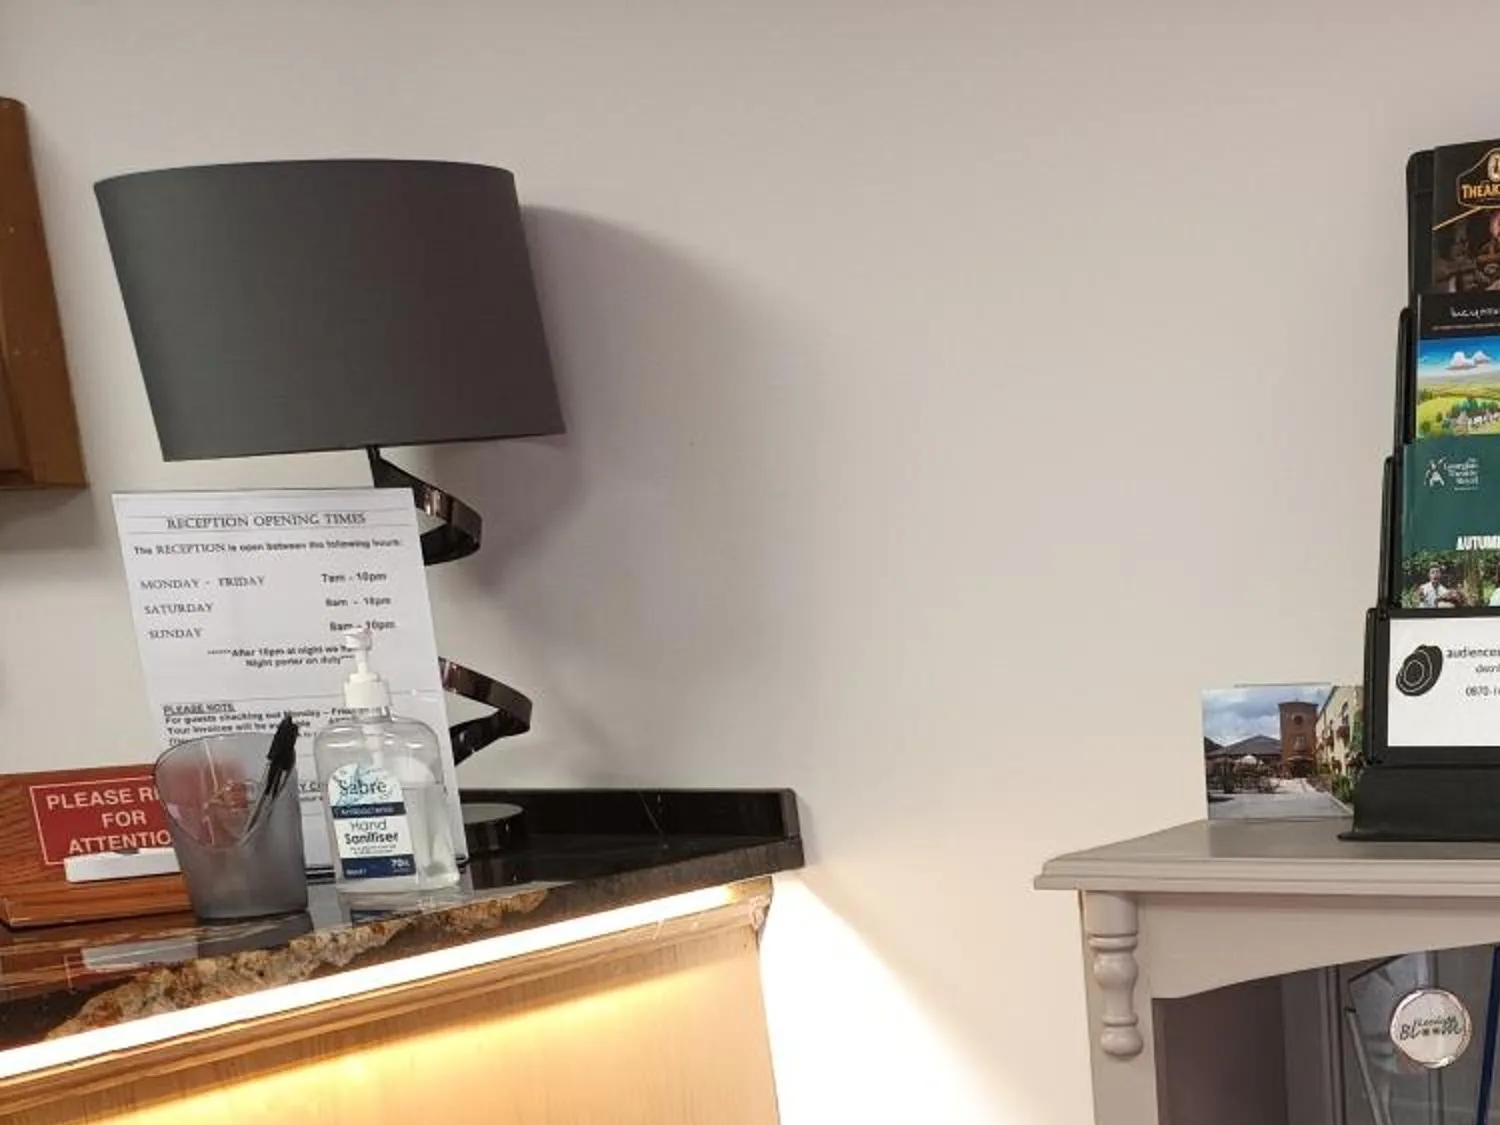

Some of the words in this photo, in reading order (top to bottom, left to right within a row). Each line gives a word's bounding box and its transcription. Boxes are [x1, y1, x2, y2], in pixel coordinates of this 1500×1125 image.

[167, 516, 249, 530] RECEPTION
[253, 514, 320, 527] OPENING
[325, 513, 366, 525] TIMES
[155, 543, 225, 555] RECEPTION
[240, 543, 264, 553] open
[266, 541, 306, 551] between
[326, 538, 371, 550] following
[140, 577, 199, 590] MONDAY
[218, 575, 266, 588] FRIDAY
[356, 571, 387, 583] 10pm
[144, 602, 214, 615] SATURDAY
[148, 627, 203, 639] SUNDAY
[165, 716, 181, 725] For
[184, 715, 216, 726] guests
[219, 712, 264, 724] checking
[338, 779, 388, 796] Sabre
[46, 788, 134, 811] PLEASE
[101, 811, 148, 829] FOR
[350, 819, 387, 831] Hand
[69, 829, 172, 854] ATTENTIO
[344, 831, 399, 845] Sanitiser
